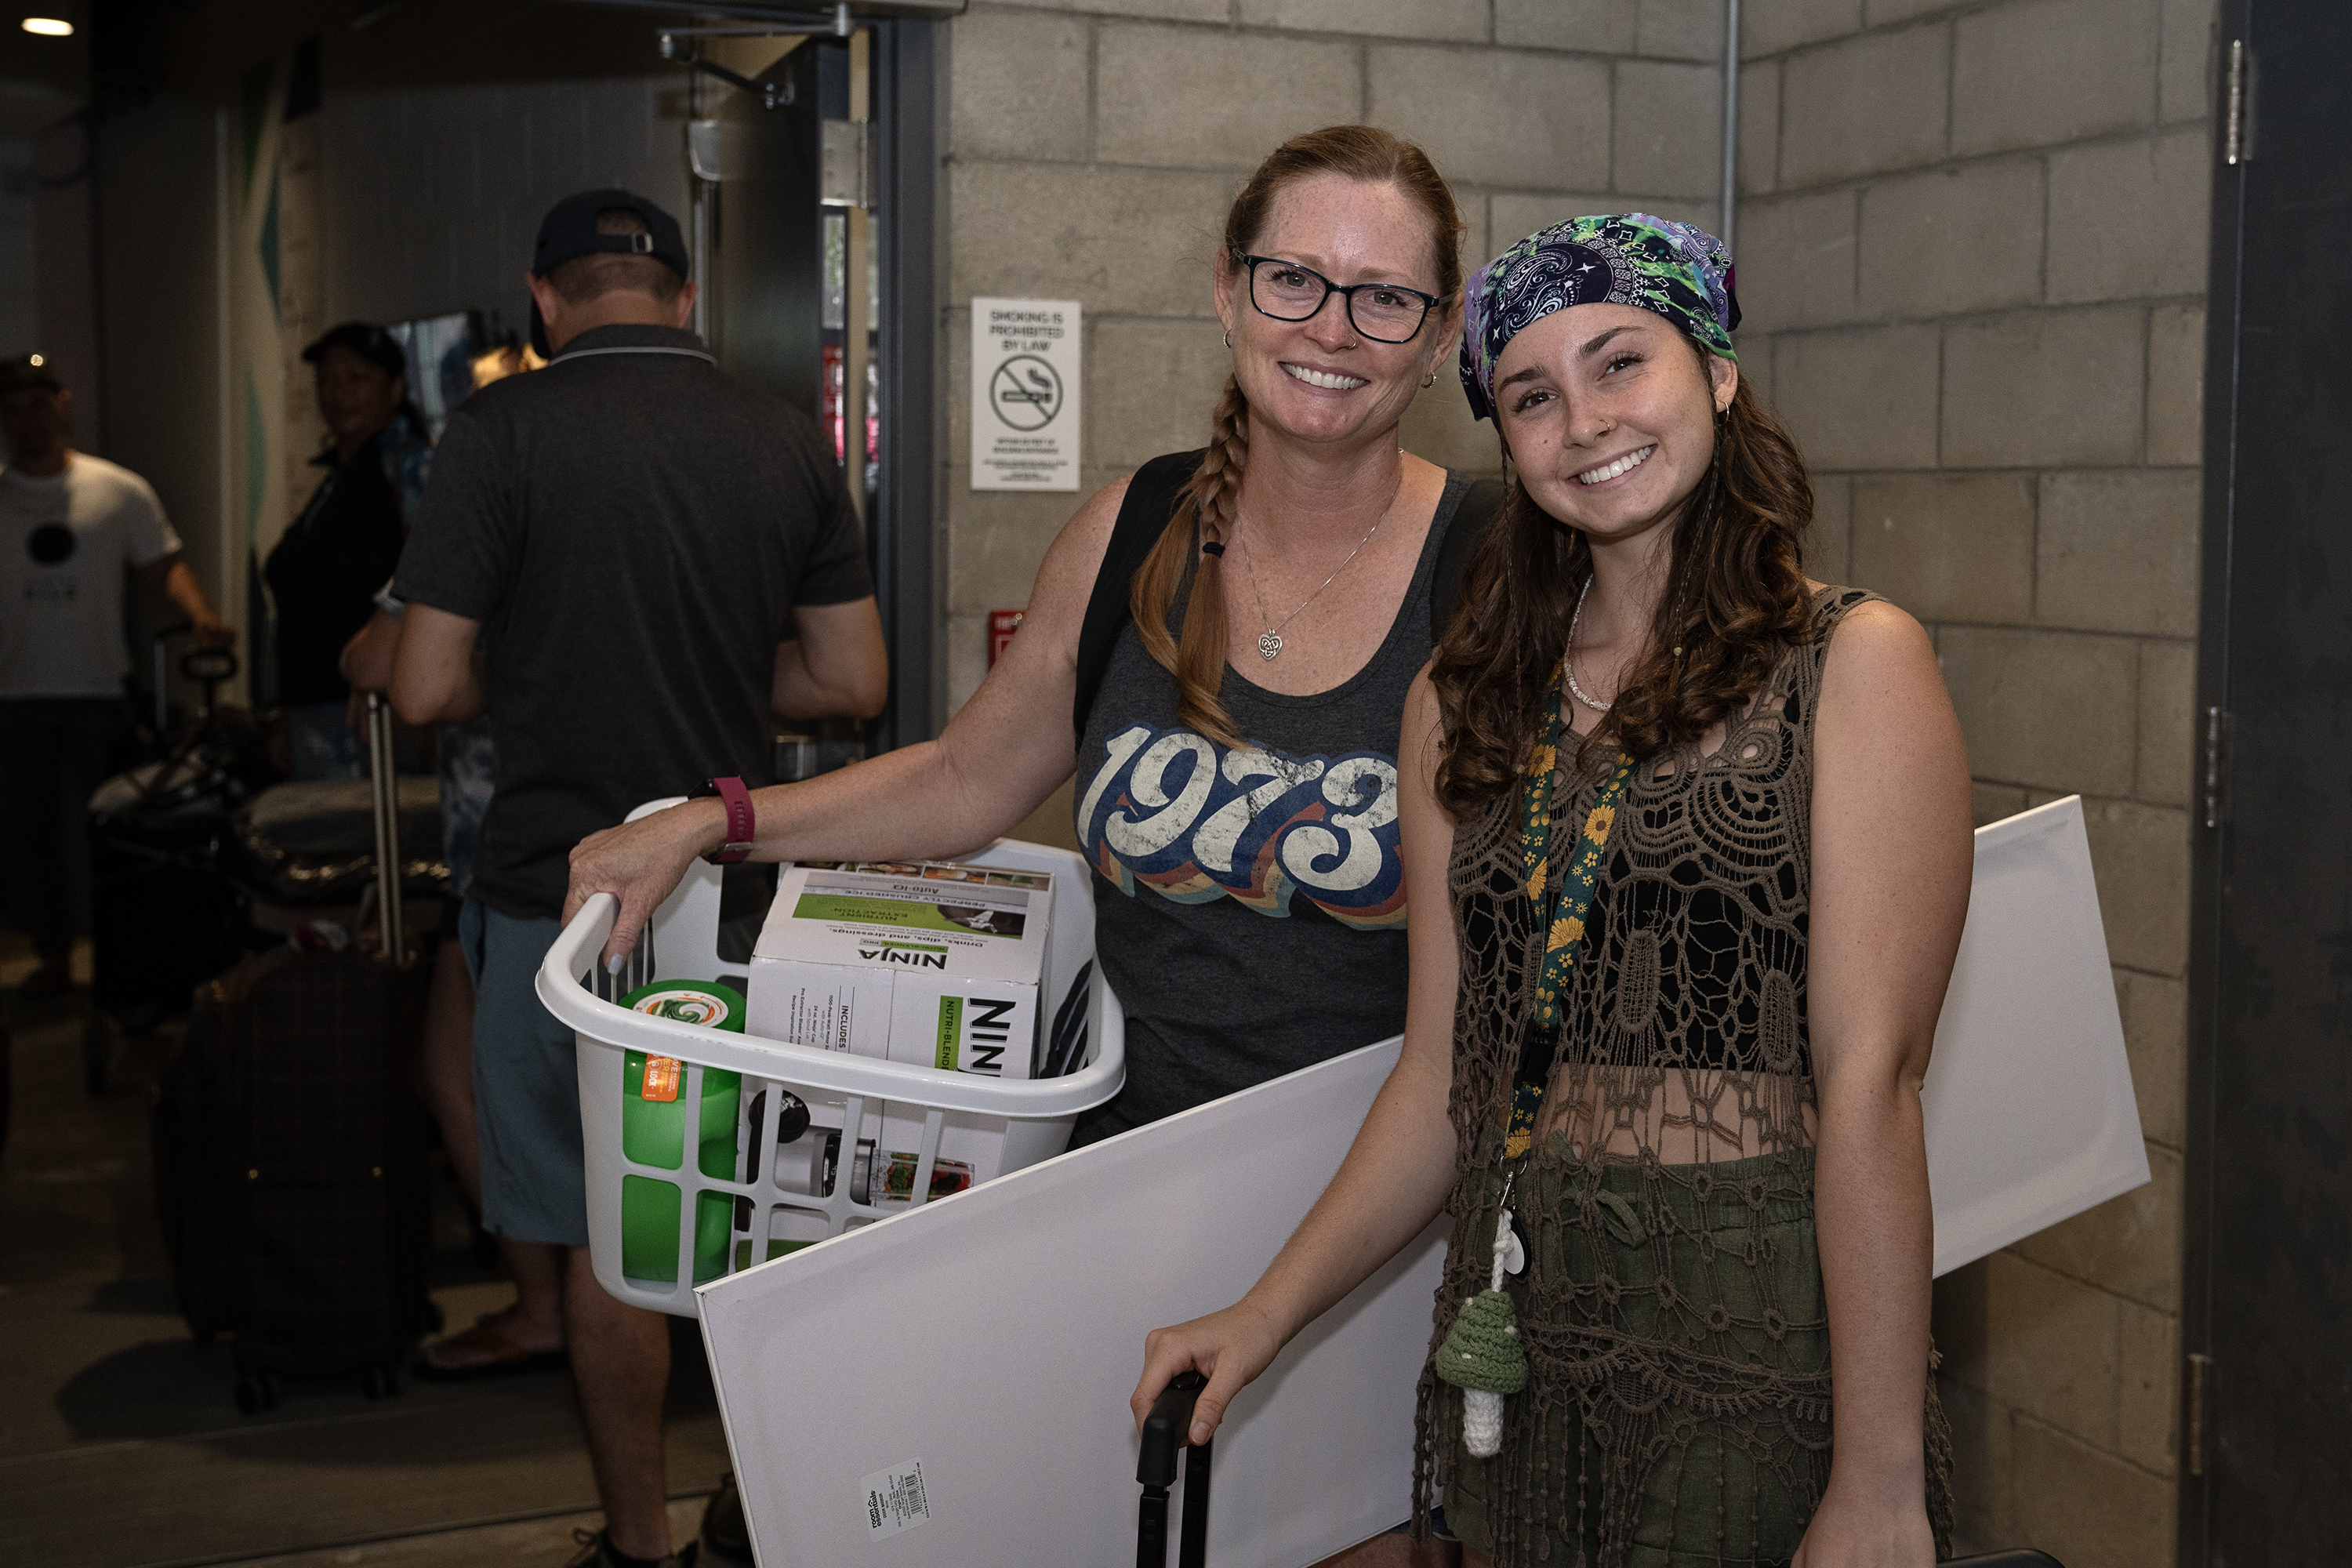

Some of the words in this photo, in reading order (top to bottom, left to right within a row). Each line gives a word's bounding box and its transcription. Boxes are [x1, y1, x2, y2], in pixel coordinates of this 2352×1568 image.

[991, 310, 1049, 324] SMOKING
[1053, 311, 1065, 325] IS
[989, 324, 1065, 339] PROHIBITED
[1001, 340, 1019, 352] BY
[1021, 341, 1051, 352] LAW
[1078, 726, 1398, 891] 1973
[829, 928, 886, 938] dressings.
[858, 948, 947, 970] NINJA
[839, 1005, 848, 1048] INCLUDES
[870, 1491, 881, 1527] essentials
